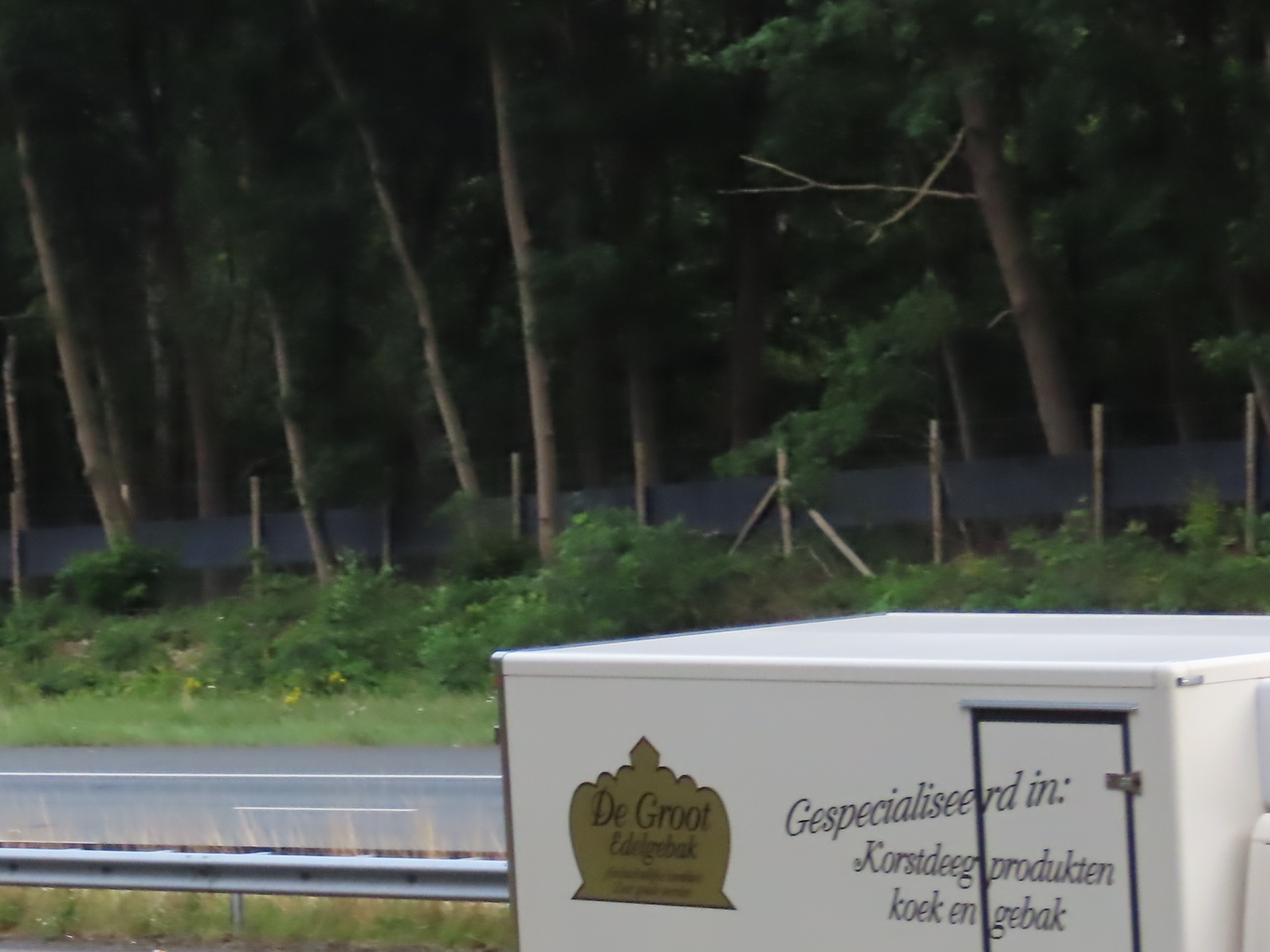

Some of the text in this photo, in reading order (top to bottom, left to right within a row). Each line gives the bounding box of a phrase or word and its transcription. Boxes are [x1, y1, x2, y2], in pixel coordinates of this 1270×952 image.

[1027, 770, 1072, 807] in:
[591, 789, 712, 831] De Groot
[609, 831, 697, 866] Edelgebak
[889, 887, 1068, 940] koek en gebak
